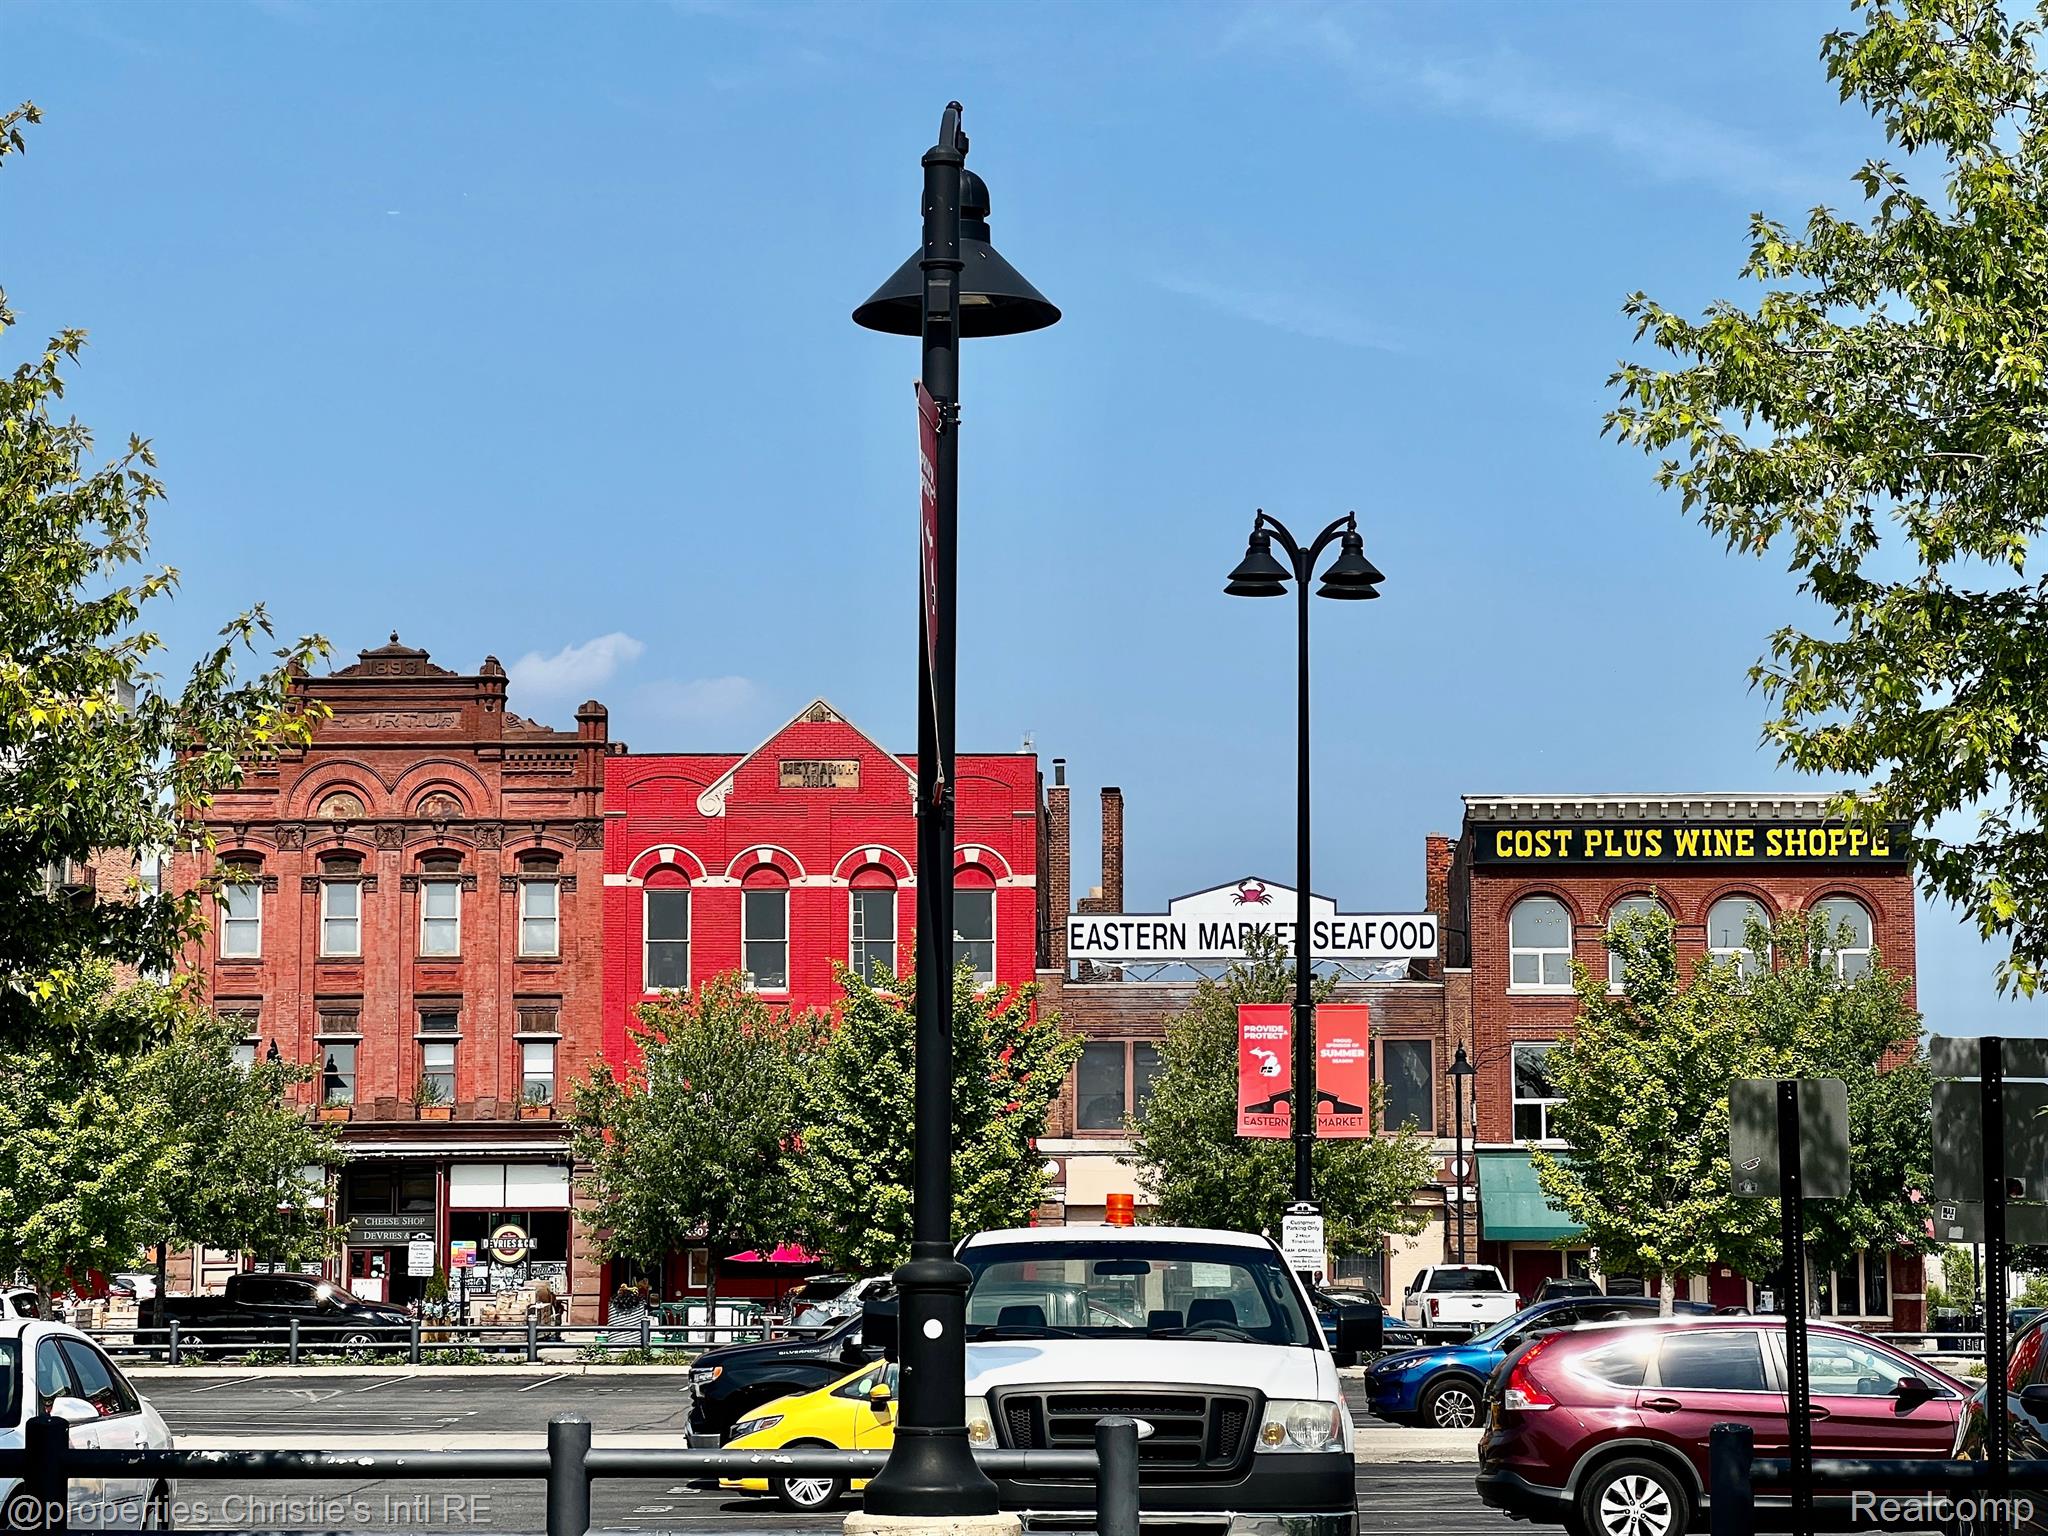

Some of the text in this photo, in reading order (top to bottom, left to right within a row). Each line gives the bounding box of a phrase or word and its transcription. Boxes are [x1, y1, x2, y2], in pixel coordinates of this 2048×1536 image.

[367, 660, 418, 675] 1893
[1496, 828, 1890, 857] COST PLUS WINE SHOPPE
[1070, 922, 1186, 951] EASTERN
[1312, 920, 1436, 951] SEAFOOD
[1243, 1032, 1283, 1040] PROTECT
[1320, 1049, 1365, 1057] SUMMER
[1243, 1116, 1289, 1127] EASTERN
[1318, 1117, 1363, 1127] MARKET
[364, 1217, 426, 1226] CHEESE SHOP
[404, 1232, 410, 1240] &
